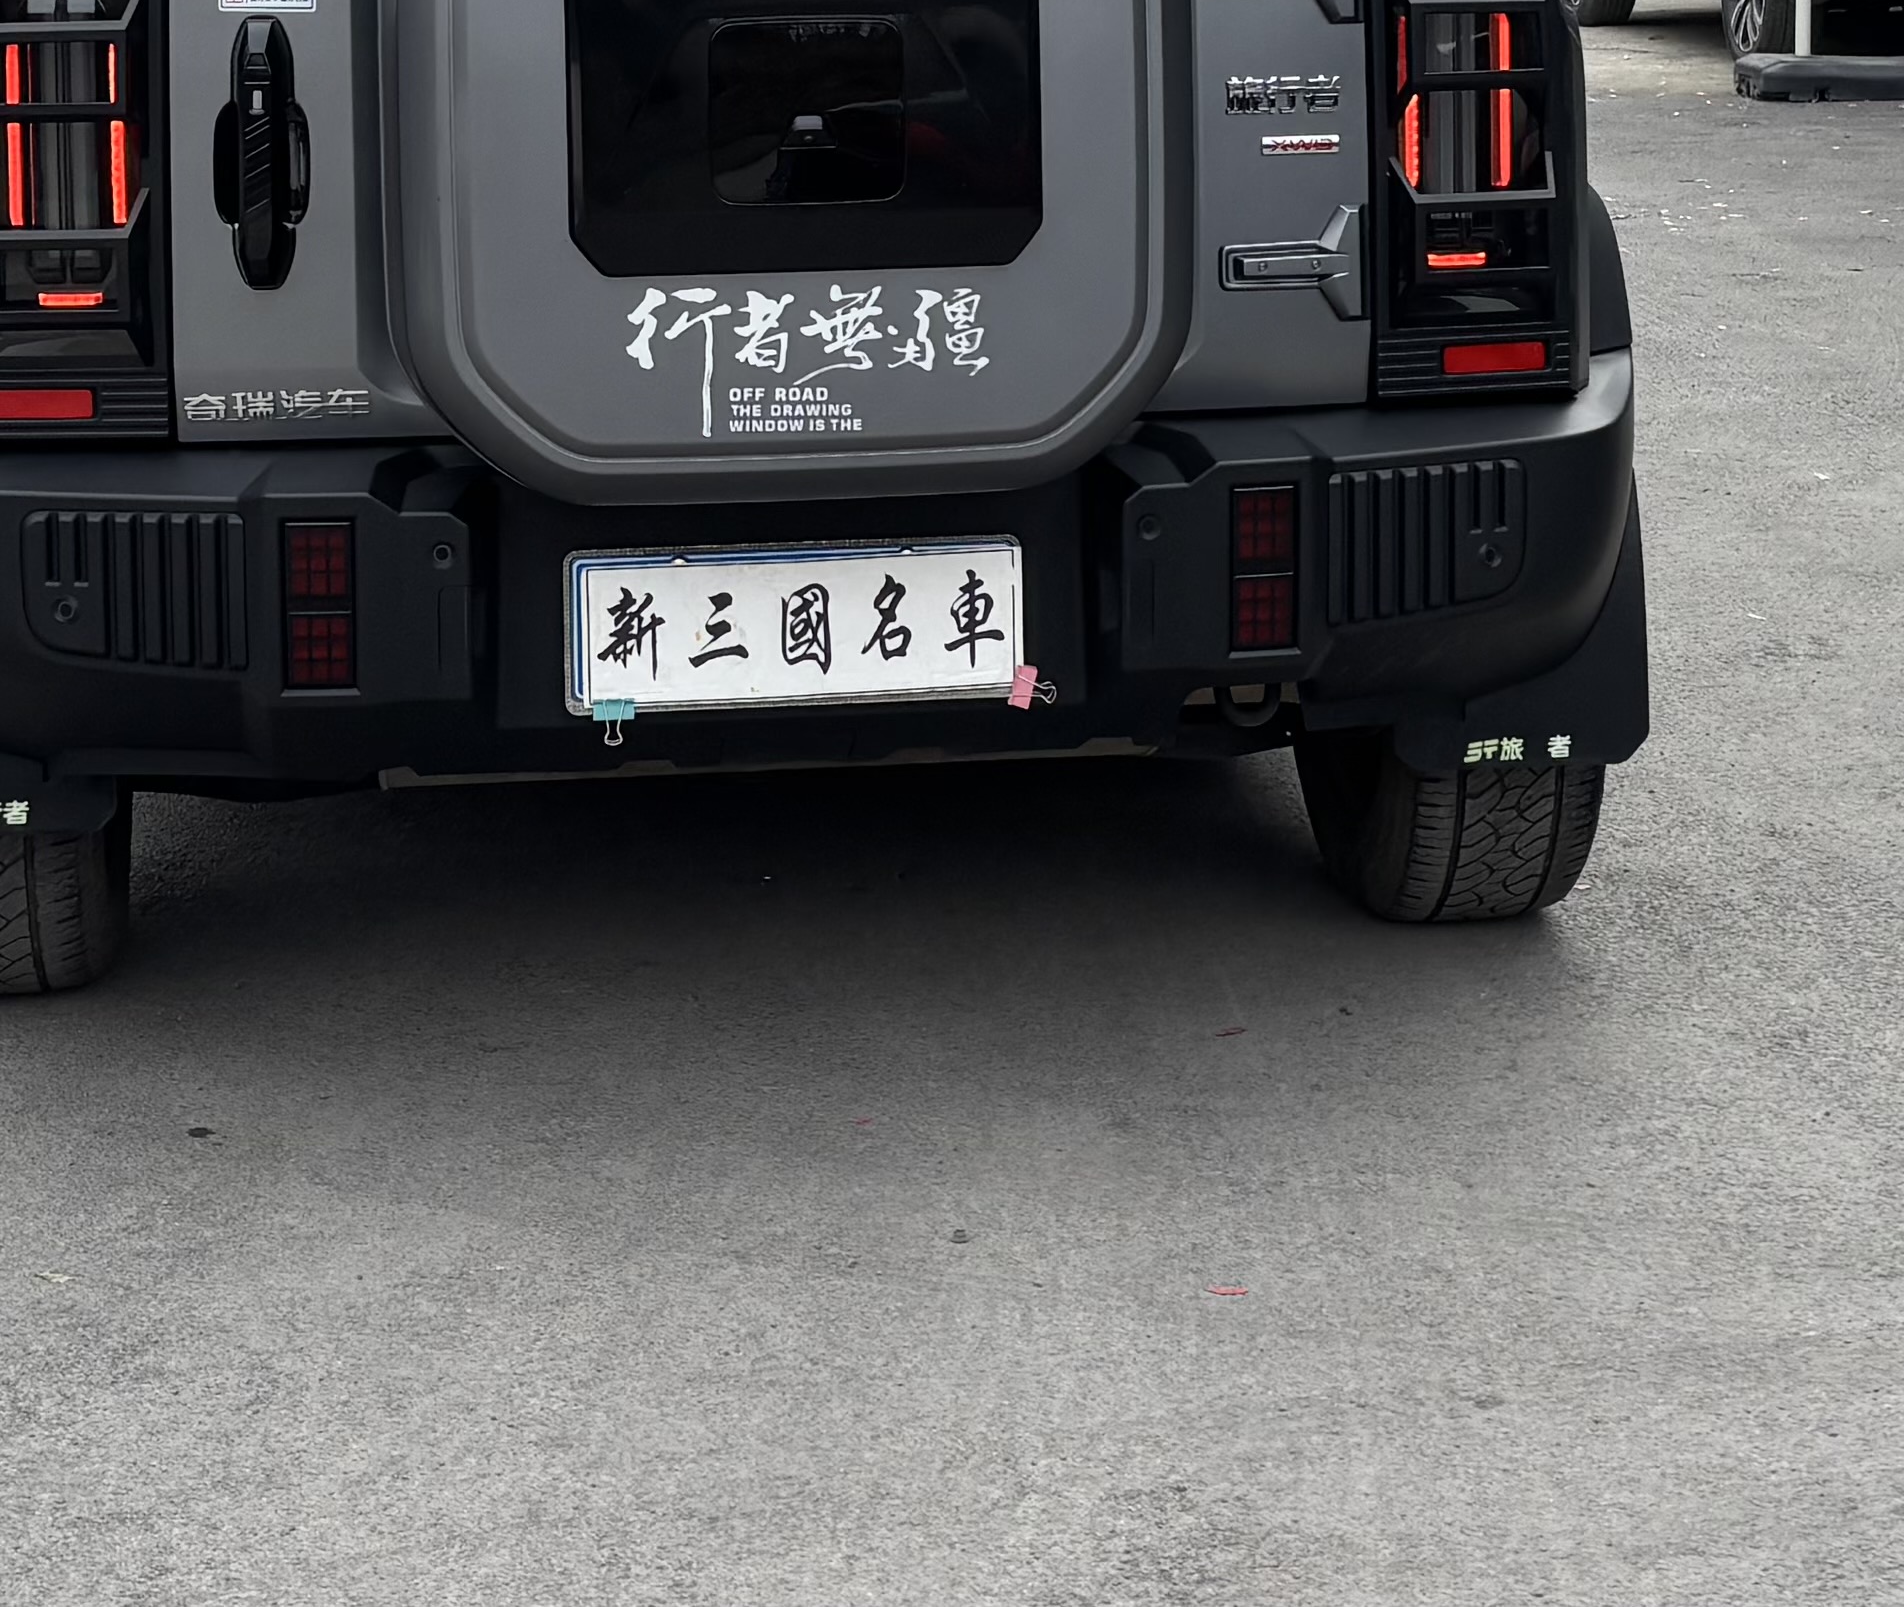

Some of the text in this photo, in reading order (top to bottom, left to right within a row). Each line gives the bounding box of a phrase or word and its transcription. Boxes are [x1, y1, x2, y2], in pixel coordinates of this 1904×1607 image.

[728, 386, 828, 402] OFF ROAD
[183, 388, 370, 421] 奇瑞汽车
[731, 403, 853, 417] THE DRAWING
[728, 418, 863, 433] WINDOW IS THE
[596, 568, 1006, 682] 新三國名車
